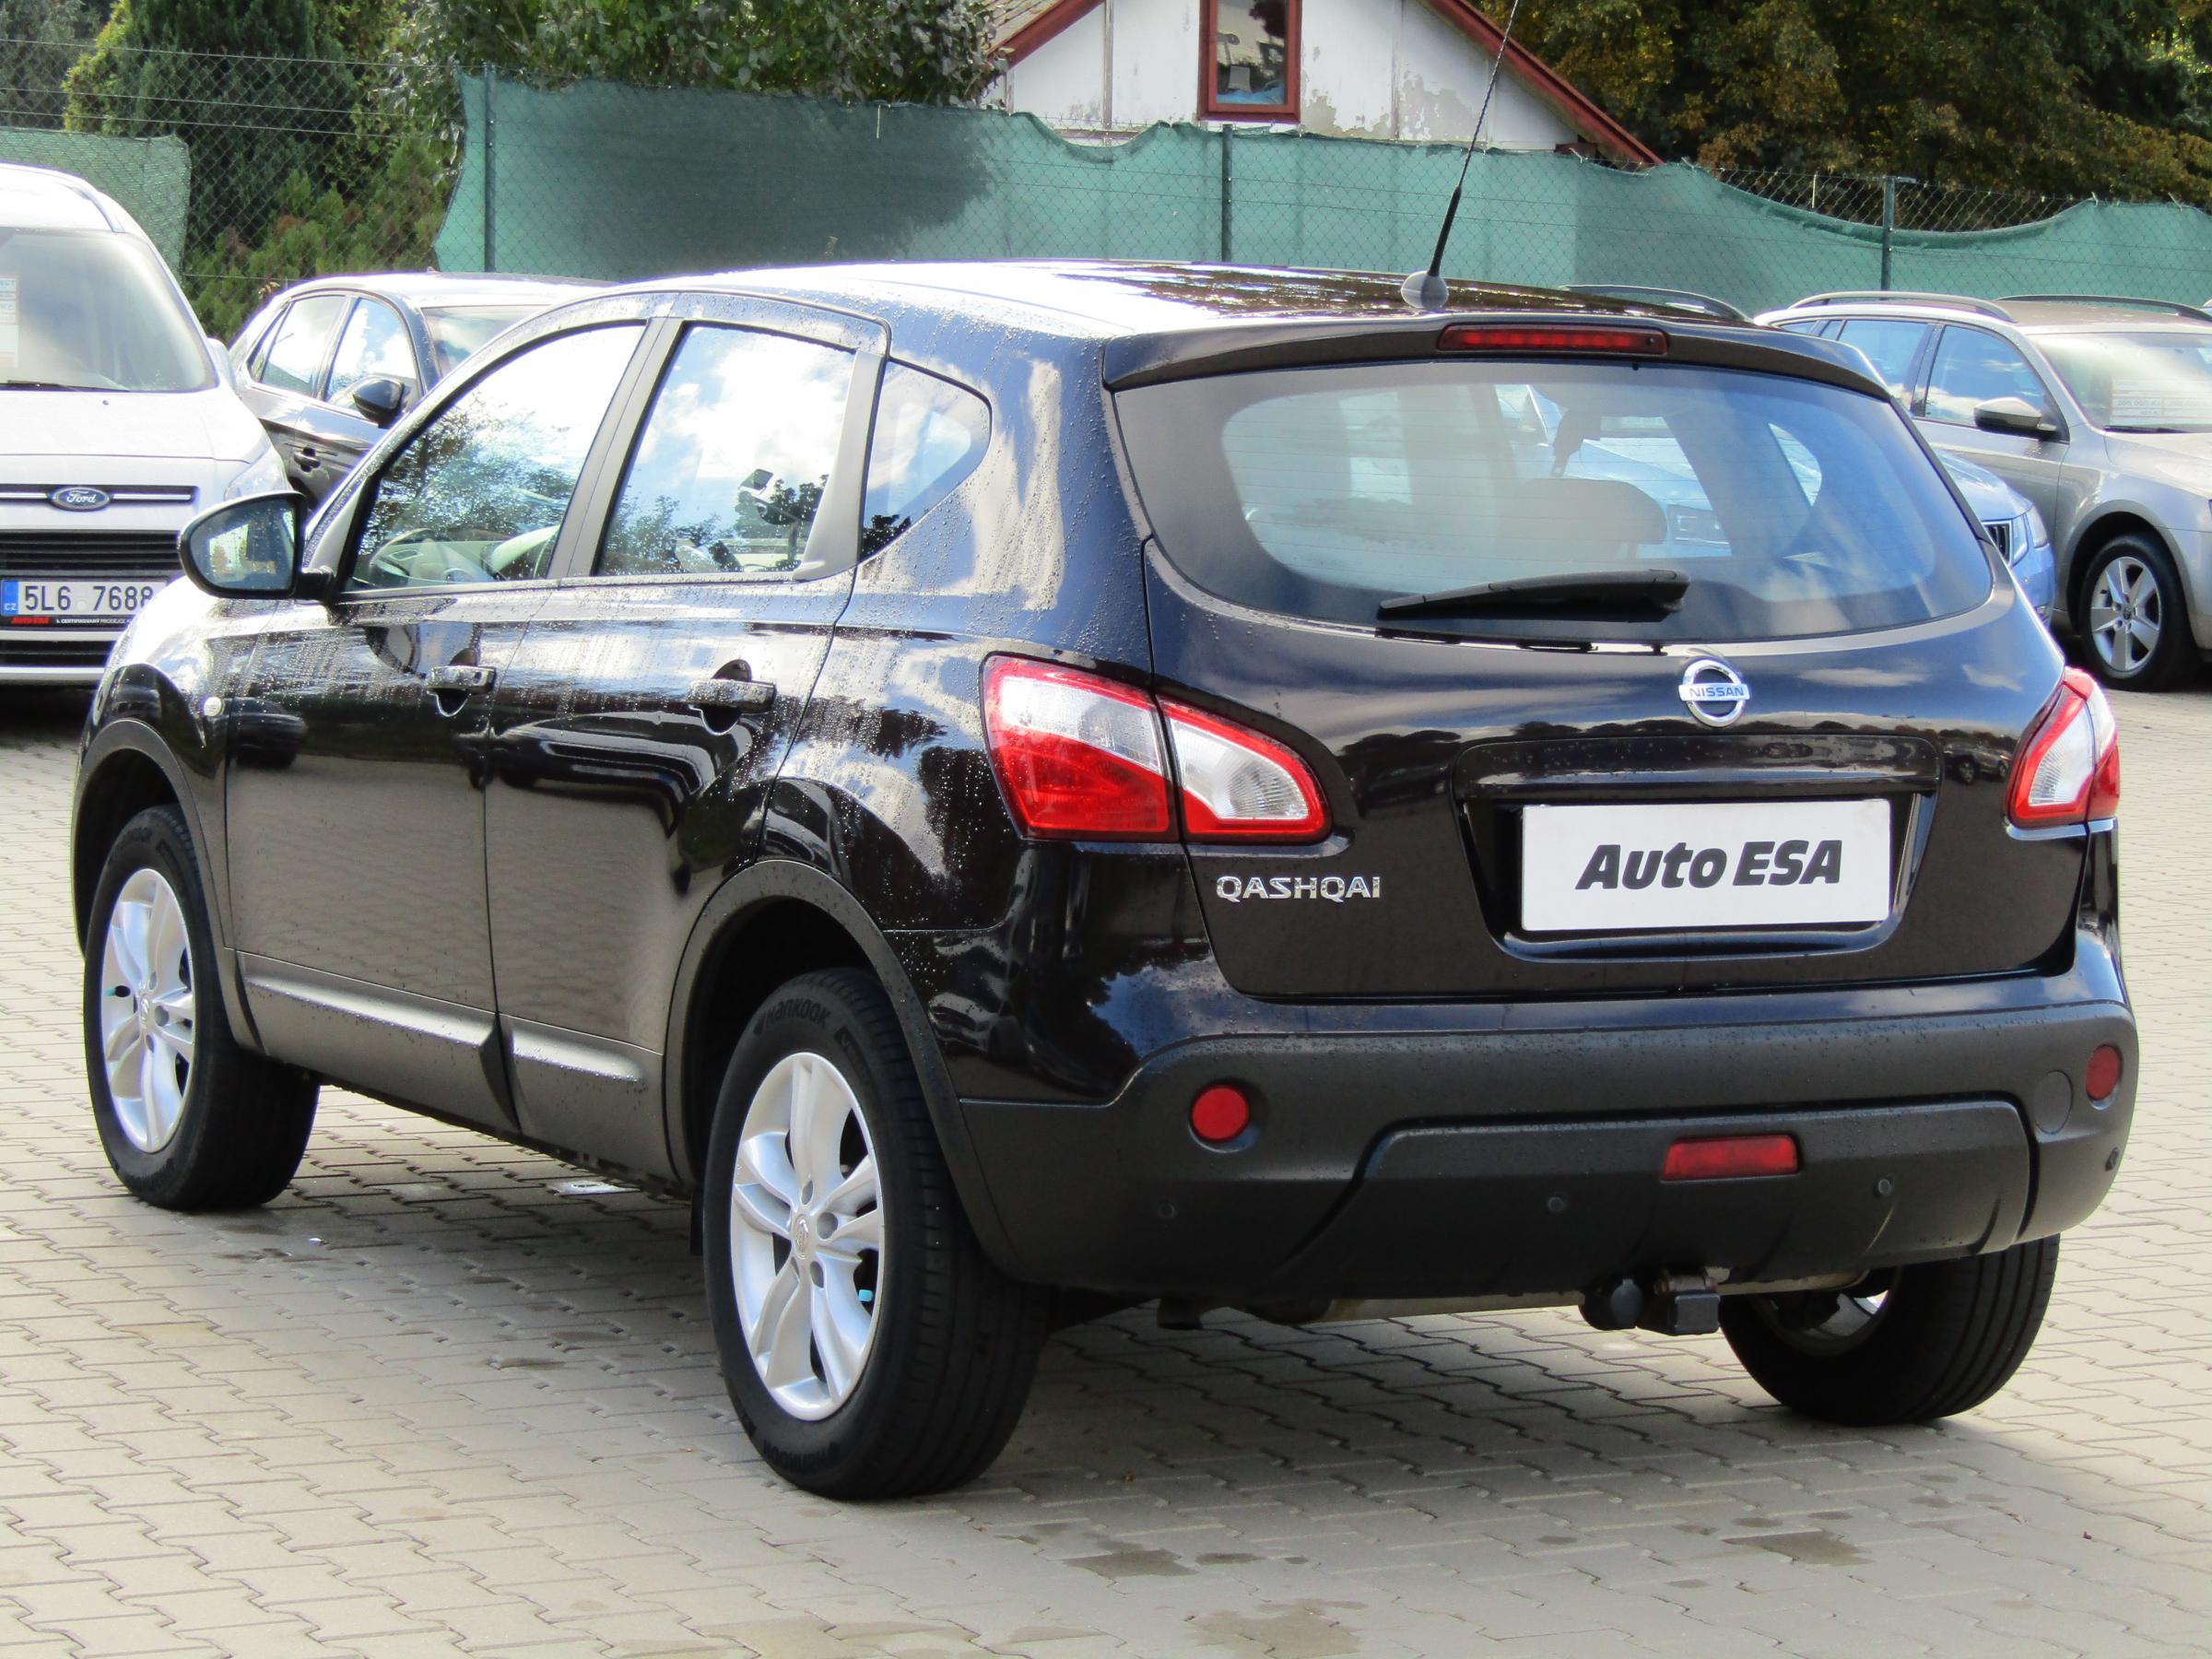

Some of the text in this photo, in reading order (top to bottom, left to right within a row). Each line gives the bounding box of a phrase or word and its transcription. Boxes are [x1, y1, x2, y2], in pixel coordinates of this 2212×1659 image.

[66, 490, 97, 503] Ford
[5, 603, 18, 611] CZ
[25, 585, 72, 611] 5L6
[1689, 687, 1744, 697] NISSAN
[1574, 840, 1842, 890] Auto ESA
[1216, 876, 1381, 903] QASHQAI
